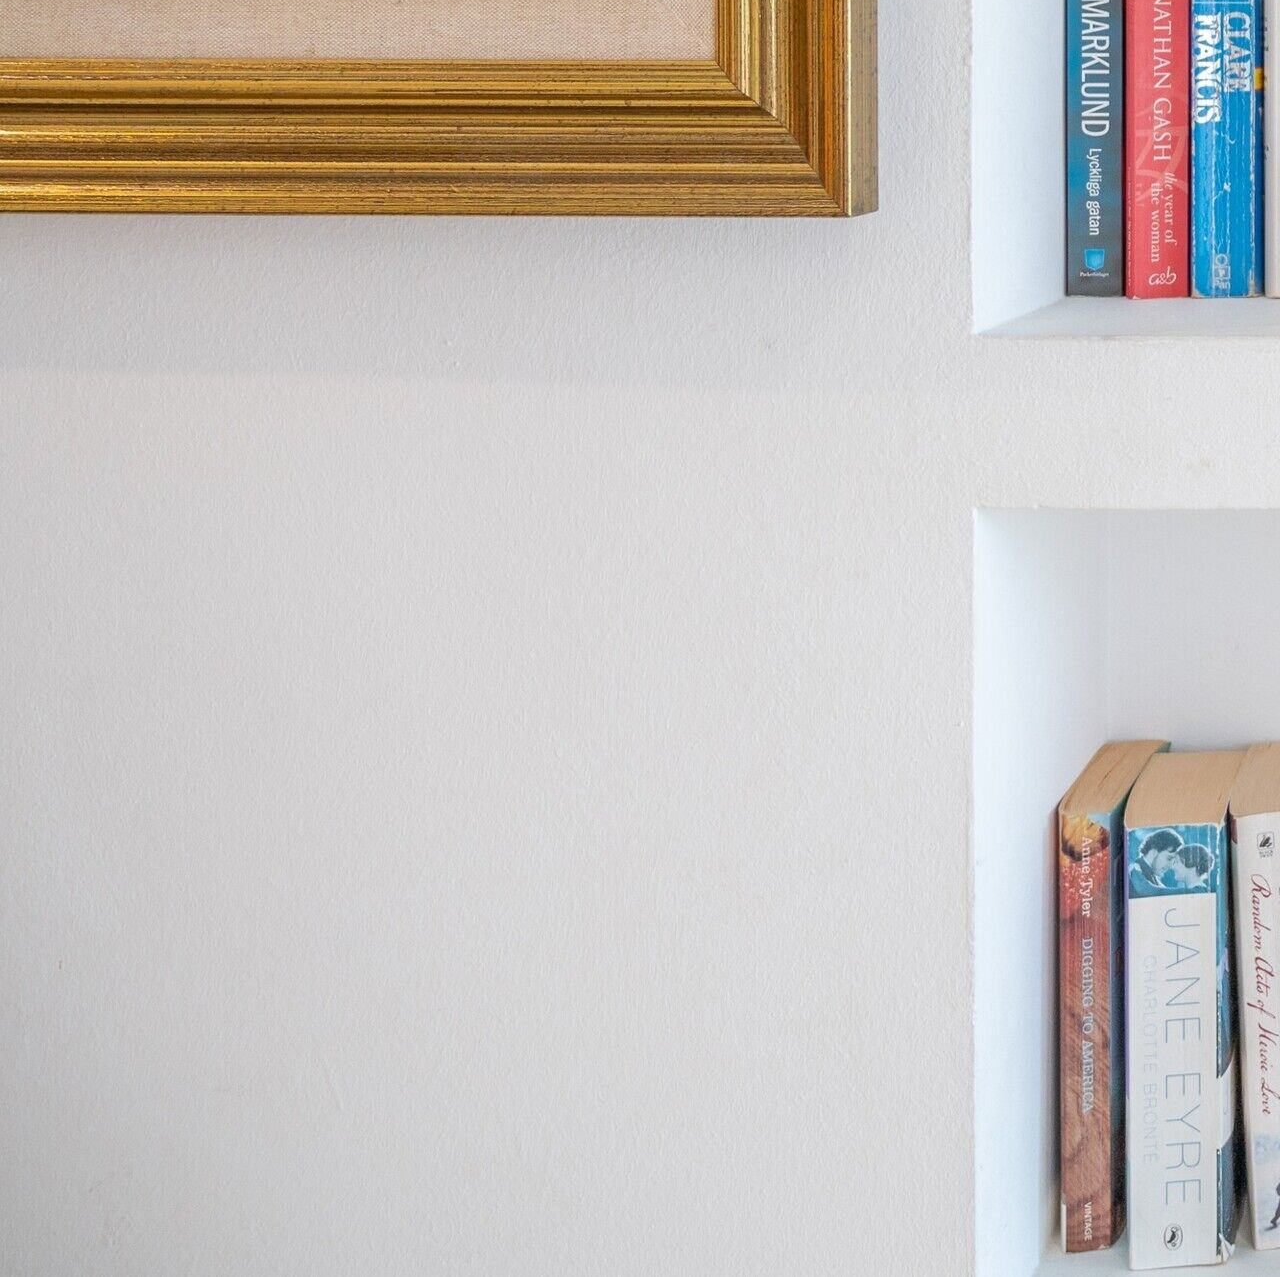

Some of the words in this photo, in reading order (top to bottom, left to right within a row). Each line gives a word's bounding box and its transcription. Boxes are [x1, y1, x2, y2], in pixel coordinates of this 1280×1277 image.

[1152, 98, 1172, 161] GASH
[1087, 148, 1103, 196] Lyckliga
[1087, 201, 1101, 235] gatan
[1164, 908, 1201, 1042] JANE
[1165, 1074, 1201, 1205] EYRE
